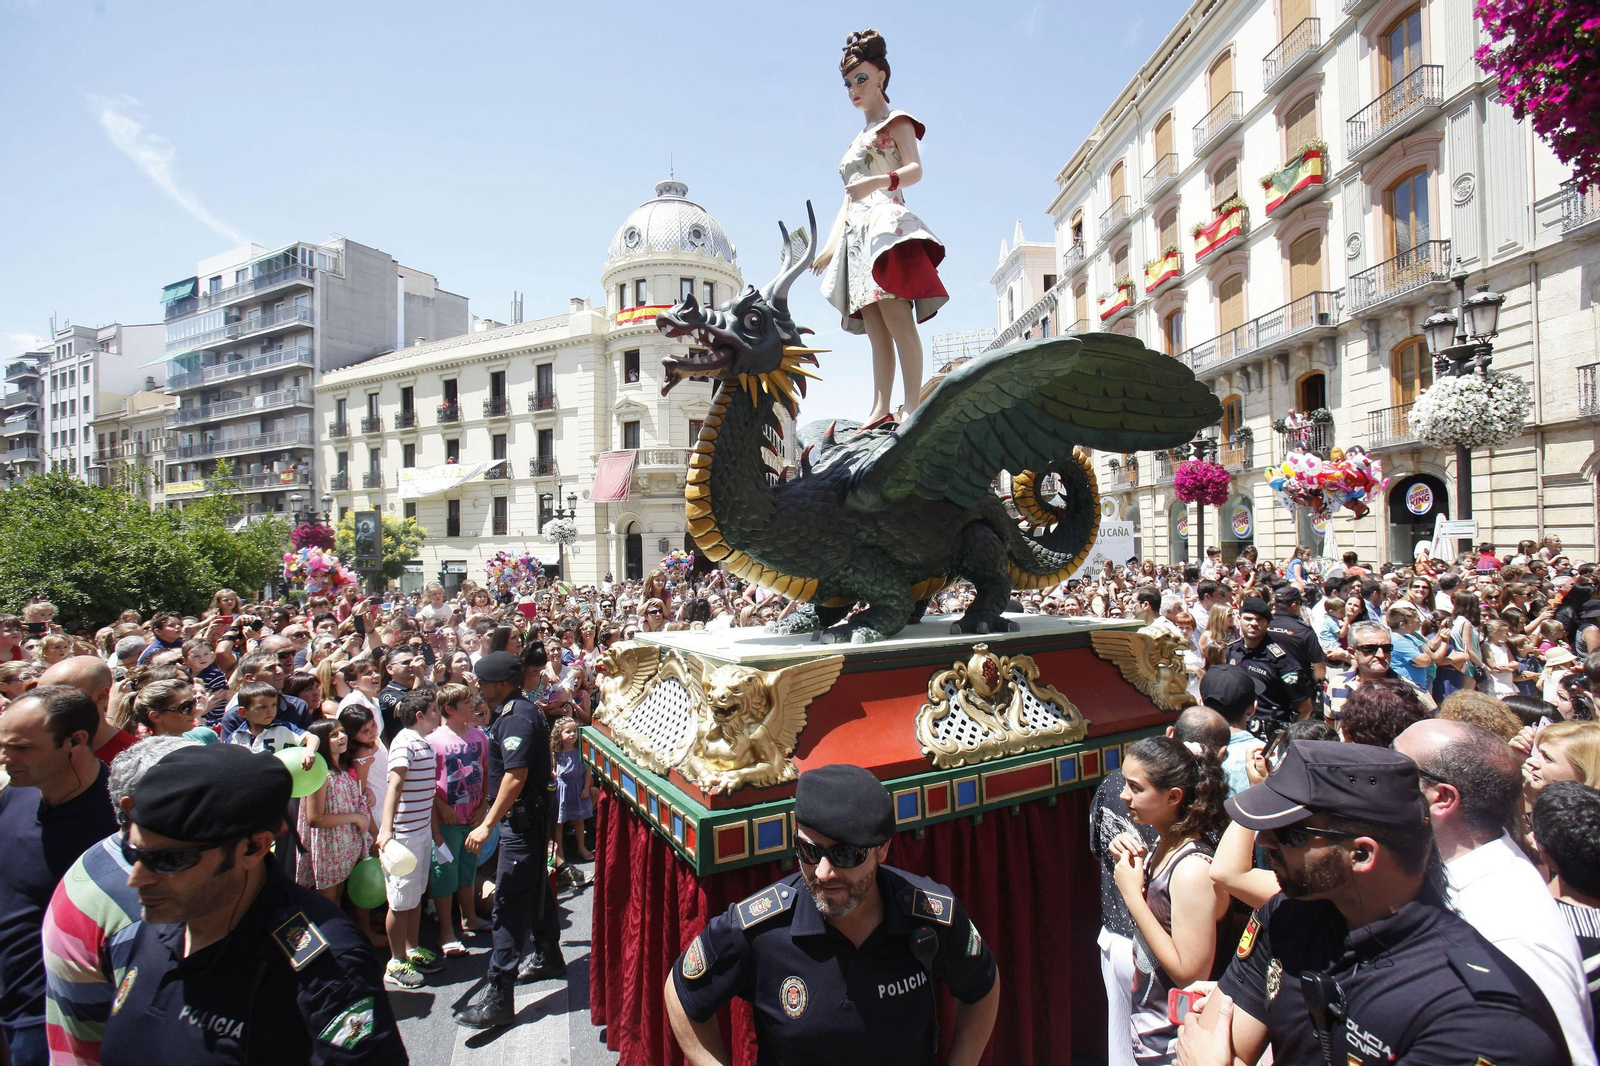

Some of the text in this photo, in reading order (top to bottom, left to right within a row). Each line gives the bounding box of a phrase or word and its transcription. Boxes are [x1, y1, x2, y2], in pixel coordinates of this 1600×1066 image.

[1409, 488, 1429, 500] BURGER
[1410, 494, 1430, 507] KING
[1311, 512, 1331, 525] KING
[1099, 526, 1130, 537] U CAÑA
[1248, 665, 1268, 676] POLICIA
[877, 971, 928, 999] POLICIA
[178, 1004, 245, 1039] POLICIA
[1345, 1017, 1394, 1059] OLICIA
[1345, 1031, 1382, 1059] CNP
